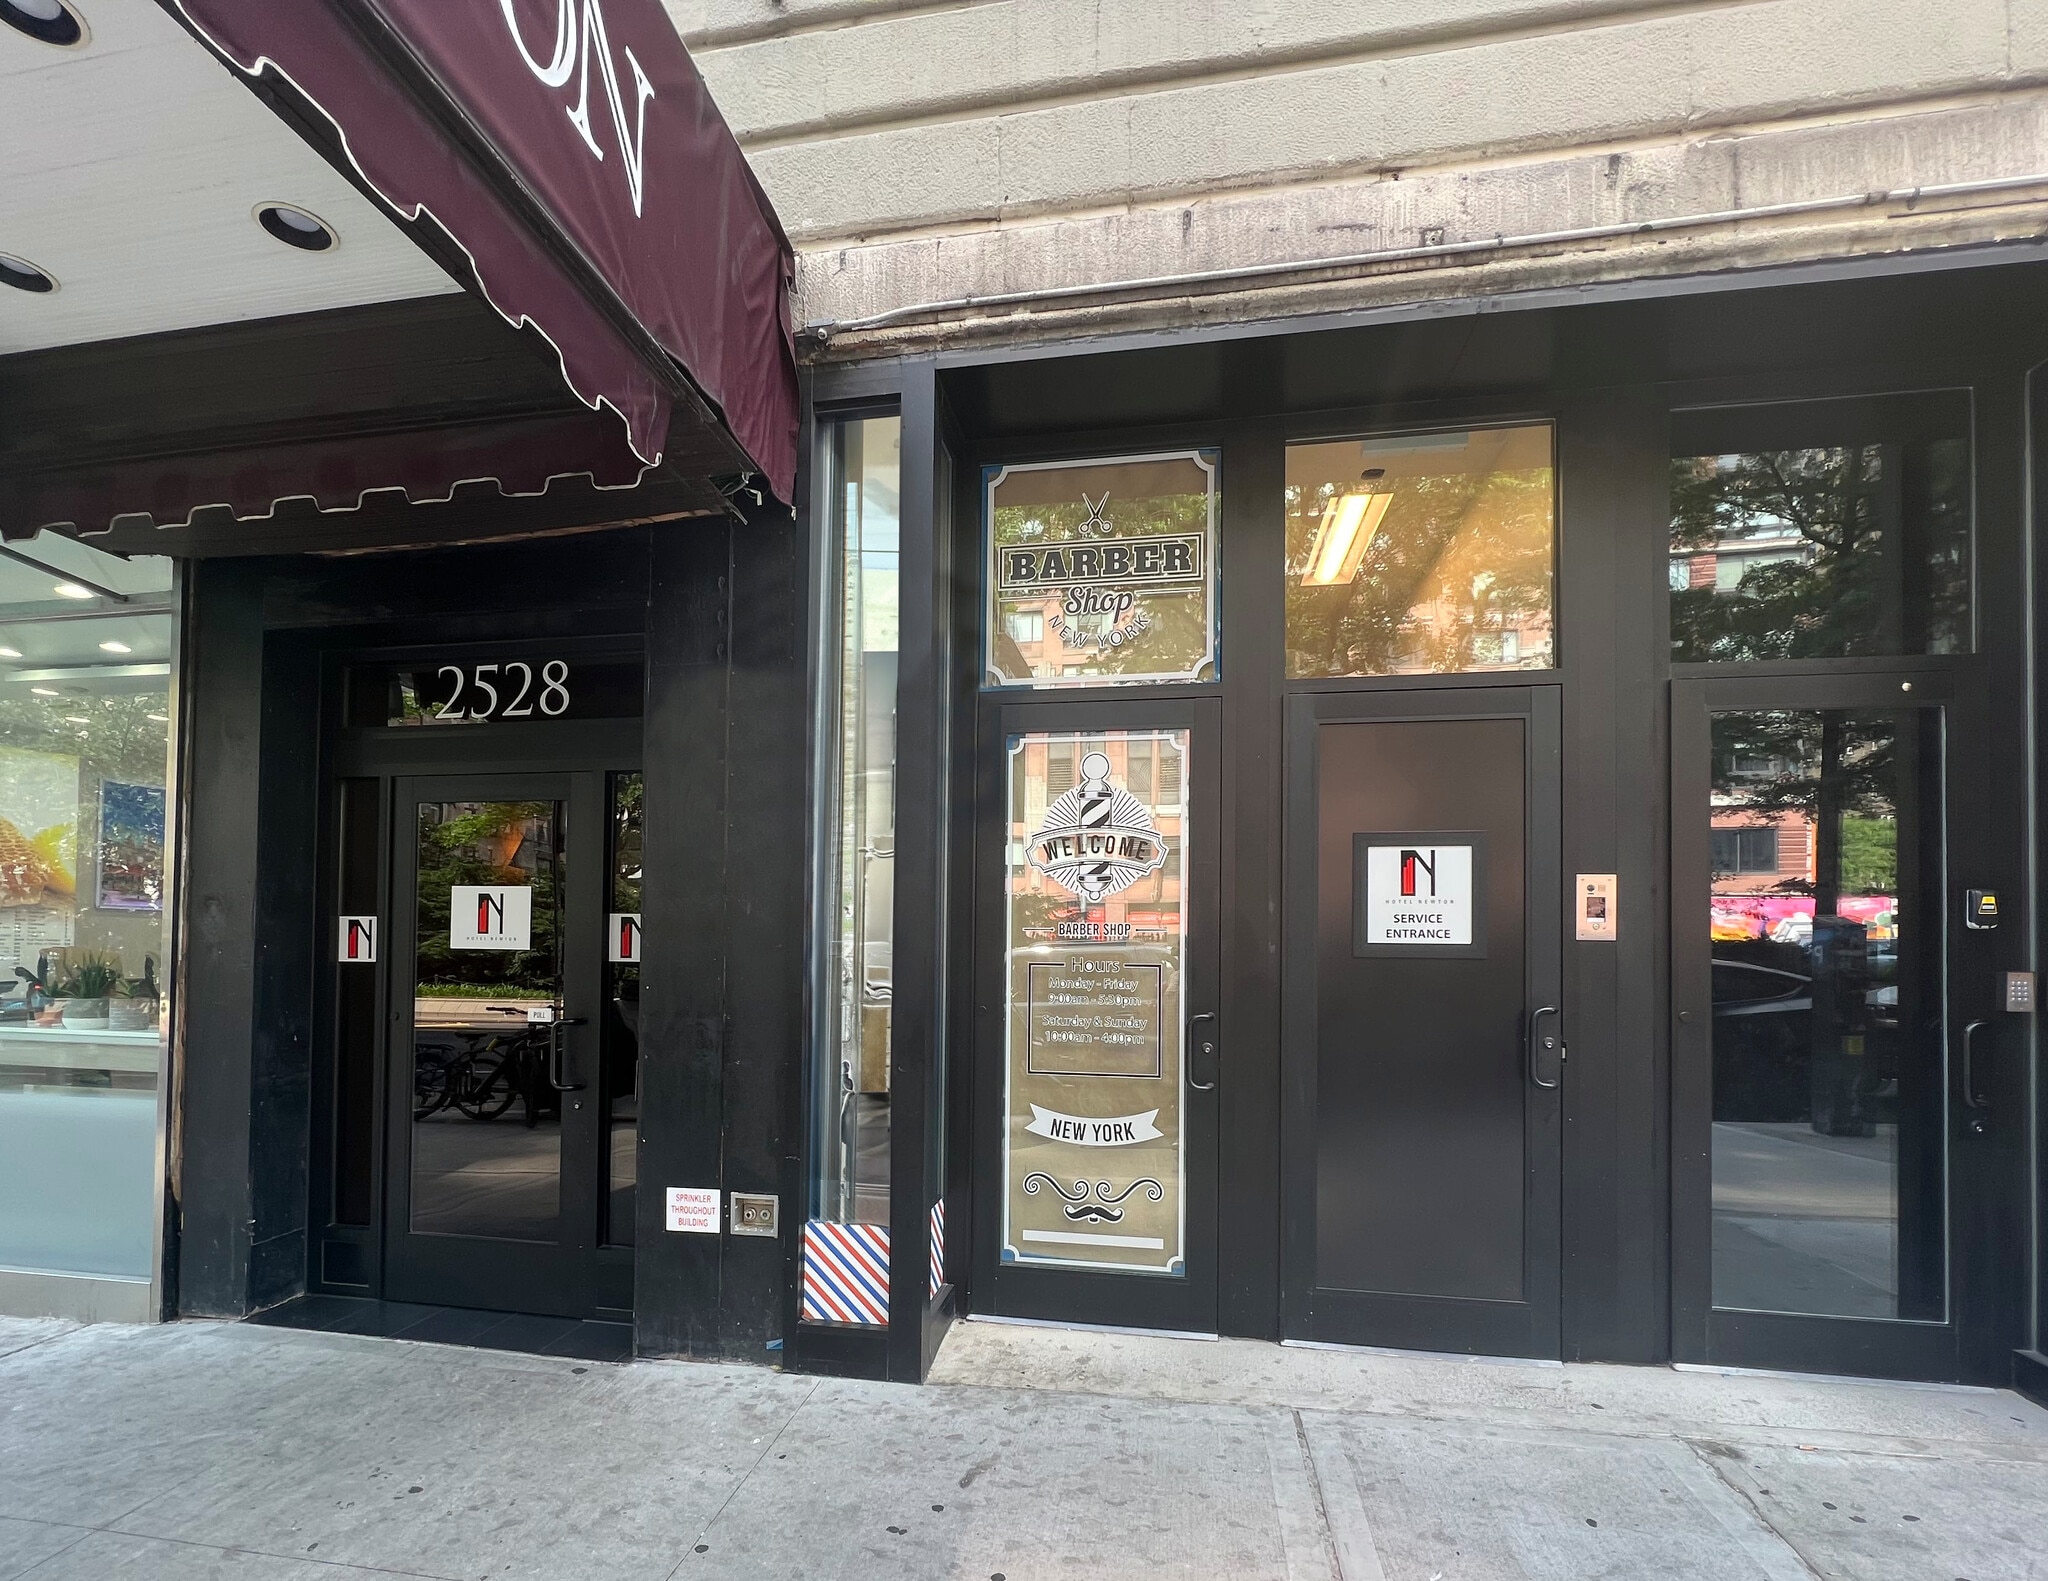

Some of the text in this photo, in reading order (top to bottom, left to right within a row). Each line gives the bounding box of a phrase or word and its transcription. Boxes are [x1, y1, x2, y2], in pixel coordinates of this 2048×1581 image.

[1009, 543, 1192, 582] BARBER
[1065, 586, 1134, 624] Shop
[1048, 612, 1152, 648] NEW YORK
[435, 660, 570, 719] 2528
[1042, 835, 1149, 861] WELCOME
[1393, 913, 1443, 924] SERVICE
[1058, 923, 1131, 937] BARBER SHOP
[1386, 929, 1451, 939] ENTRANCE
[1071, 957, 1120, 973] Hours
[1048, 977, 1095, 991] Monday
[1103, 978, 1139, 992] Friday
[1048, 993, 1089, 1005] 9:00am
[1097, 994, 1142, 1008] 5:30pm
[1042, 1014, 1148, 1031] Saturday & Sunday
[1044, 1030, 1093, 1043] 10:00am
[1101, 1032, 1145, 1047] 4:00pm
[1050, 1118, 1136, 1142] NEW YORK
[675, 1193, 712, 1204] SPRINKLER
[671, 1205, 716, 1216] THROUGHOUT
[678, 1217, 709, 1228] BUILDING
